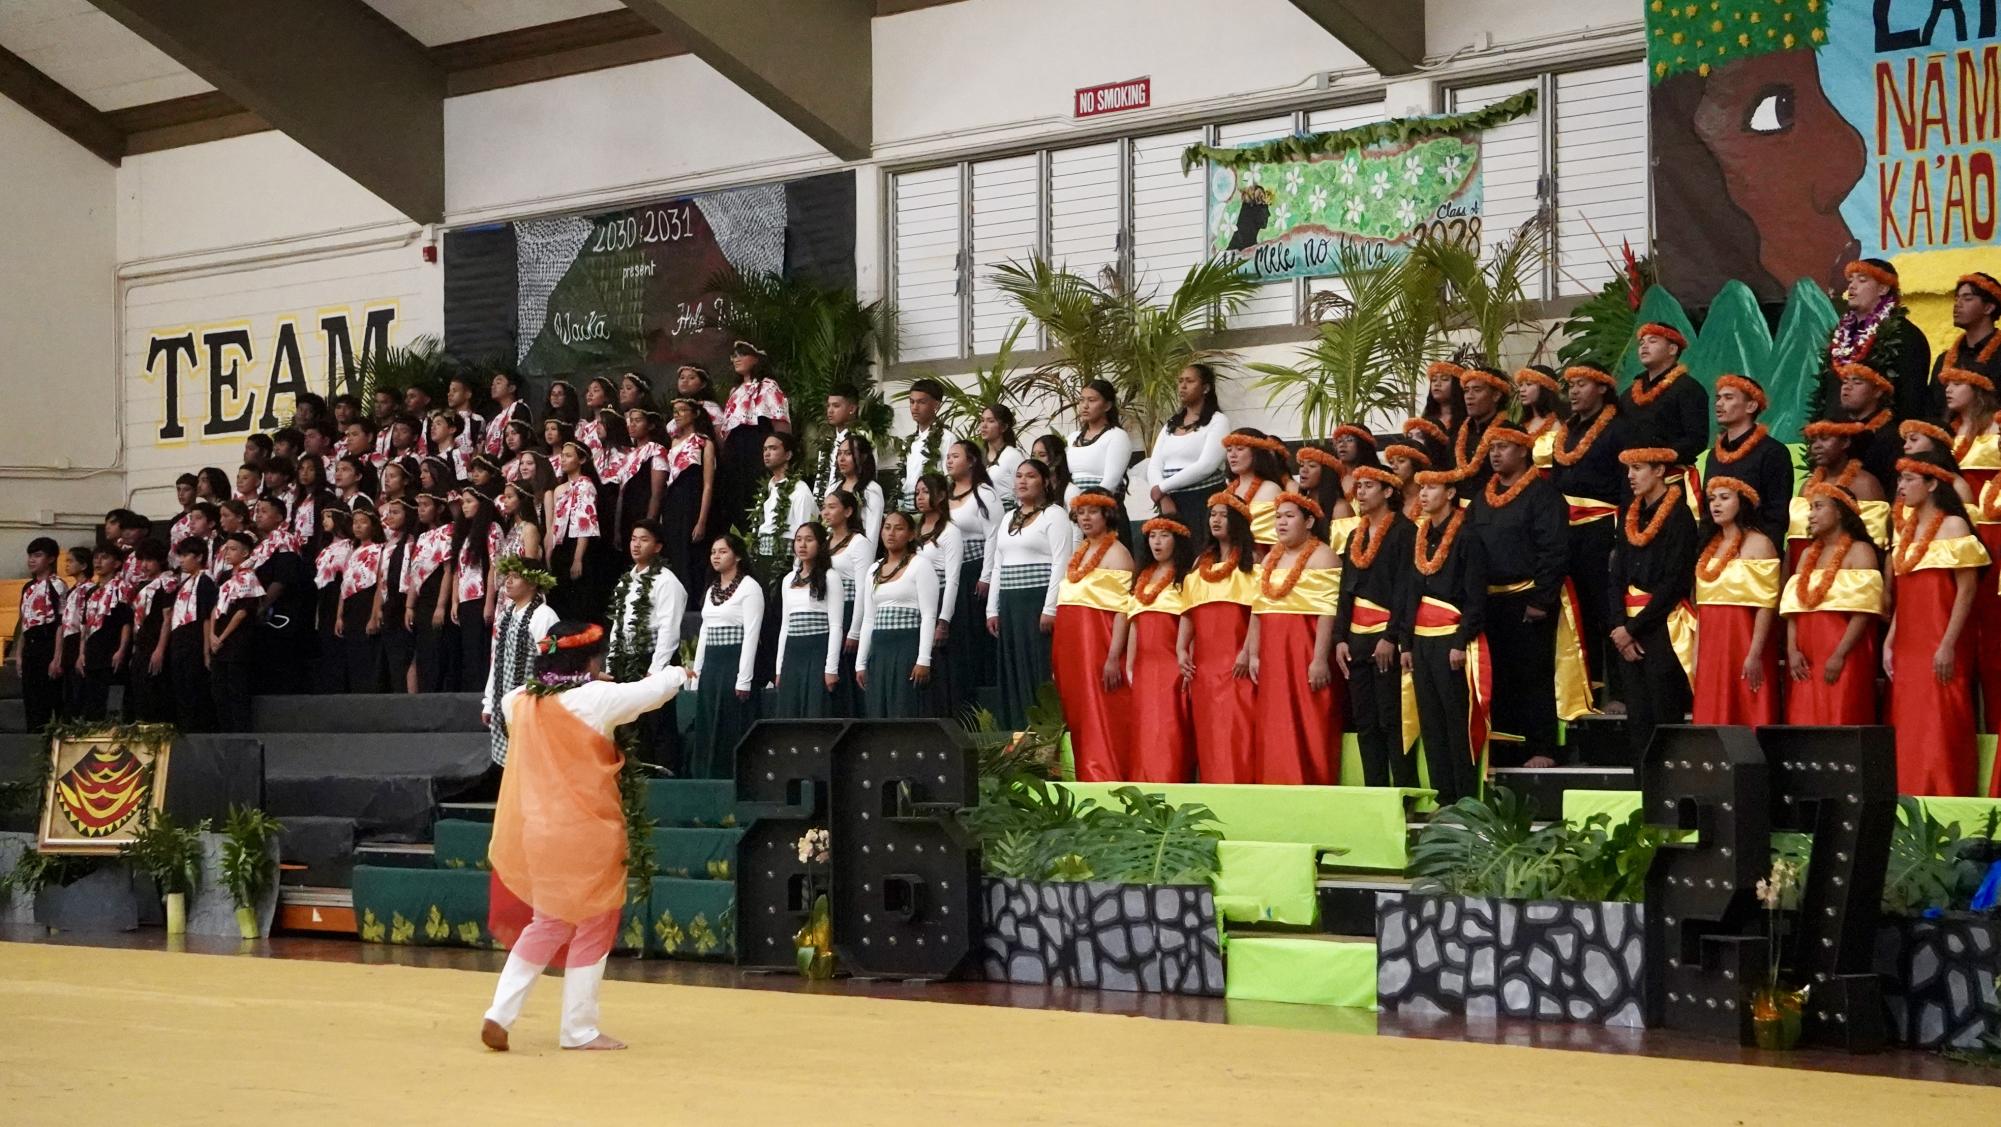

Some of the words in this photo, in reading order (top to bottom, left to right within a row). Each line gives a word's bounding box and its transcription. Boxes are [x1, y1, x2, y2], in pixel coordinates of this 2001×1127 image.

[1080, 91, 1095, 114] NO
[1097, 83, 1146, 111] SMOKING
[1437, 201, 1467, 219] Class
[593, 217, 637, 252] 2030
[644, 206, 694, 243] 2031
[622, 260, 657, 290] present
[146, 307, 396, 440] TEAM
